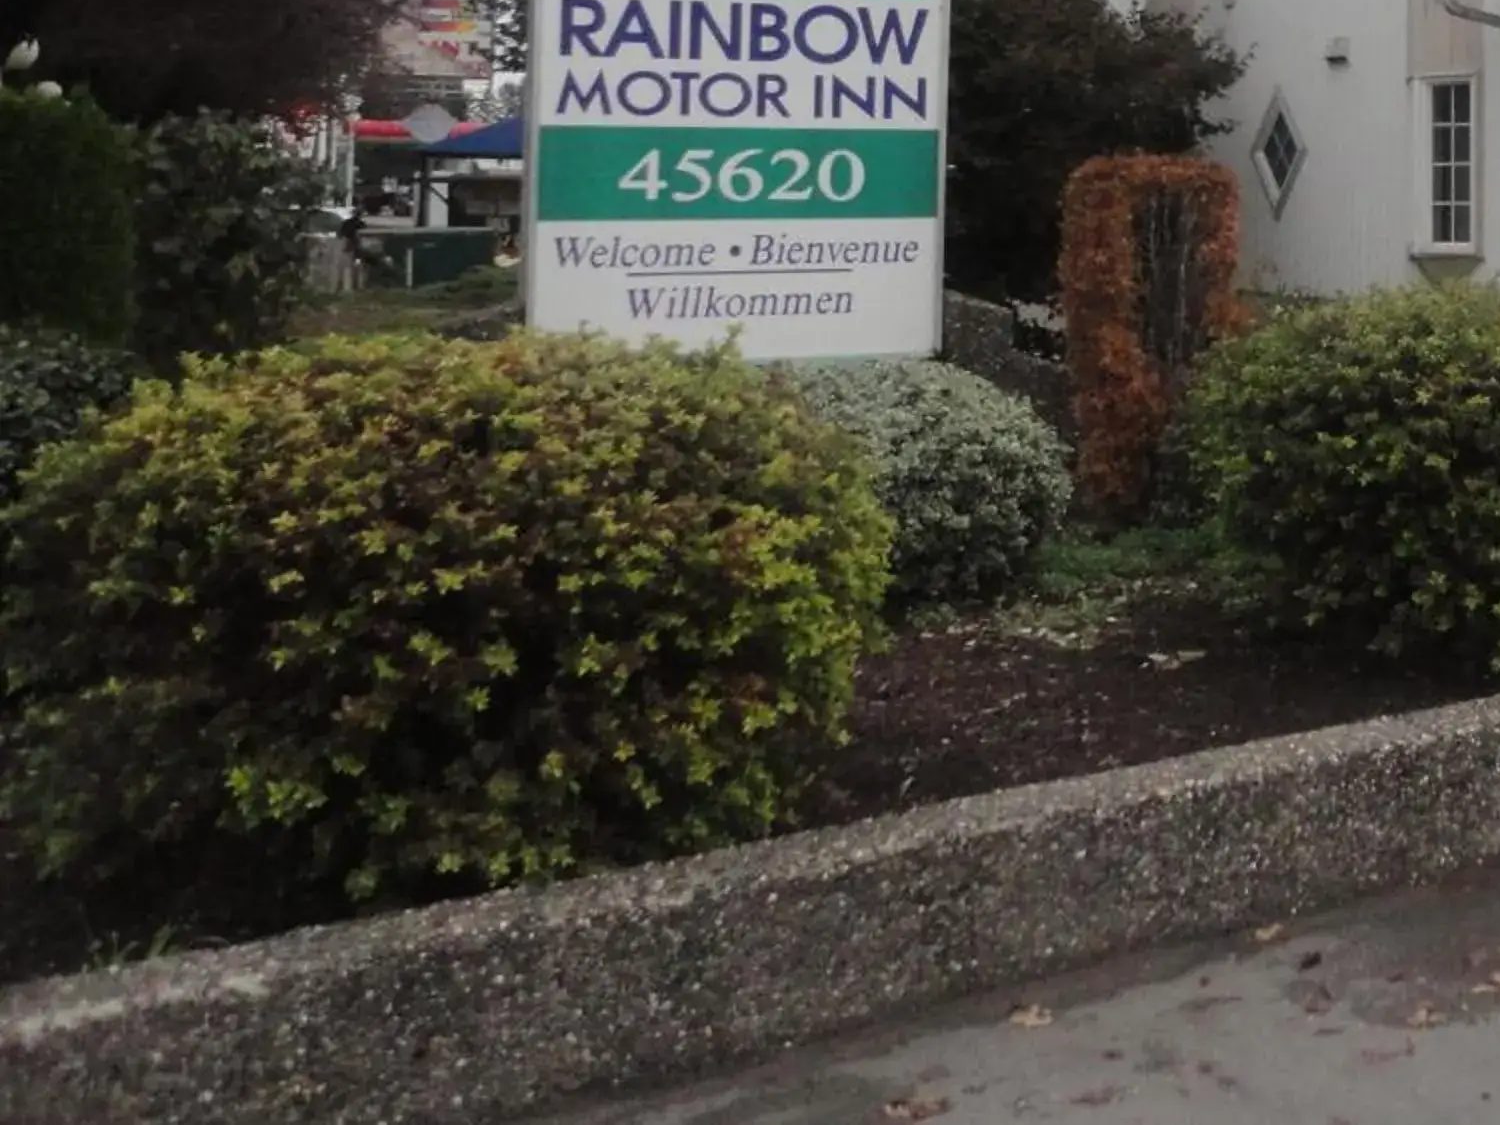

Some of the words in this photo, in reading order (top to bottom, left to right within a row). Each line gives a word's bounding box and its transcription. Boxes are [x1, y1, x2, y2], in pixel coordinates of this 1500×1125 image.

[556, 69, 790, 118] MOTOR
[813, 75, 927, 119] INN
[618, 148, 866, 203] 45620
[553, 235, 716, 268] Welcome
[750, 233, 919, 266] Bienvenue
[627, 286, 854, 320] Willkommen
